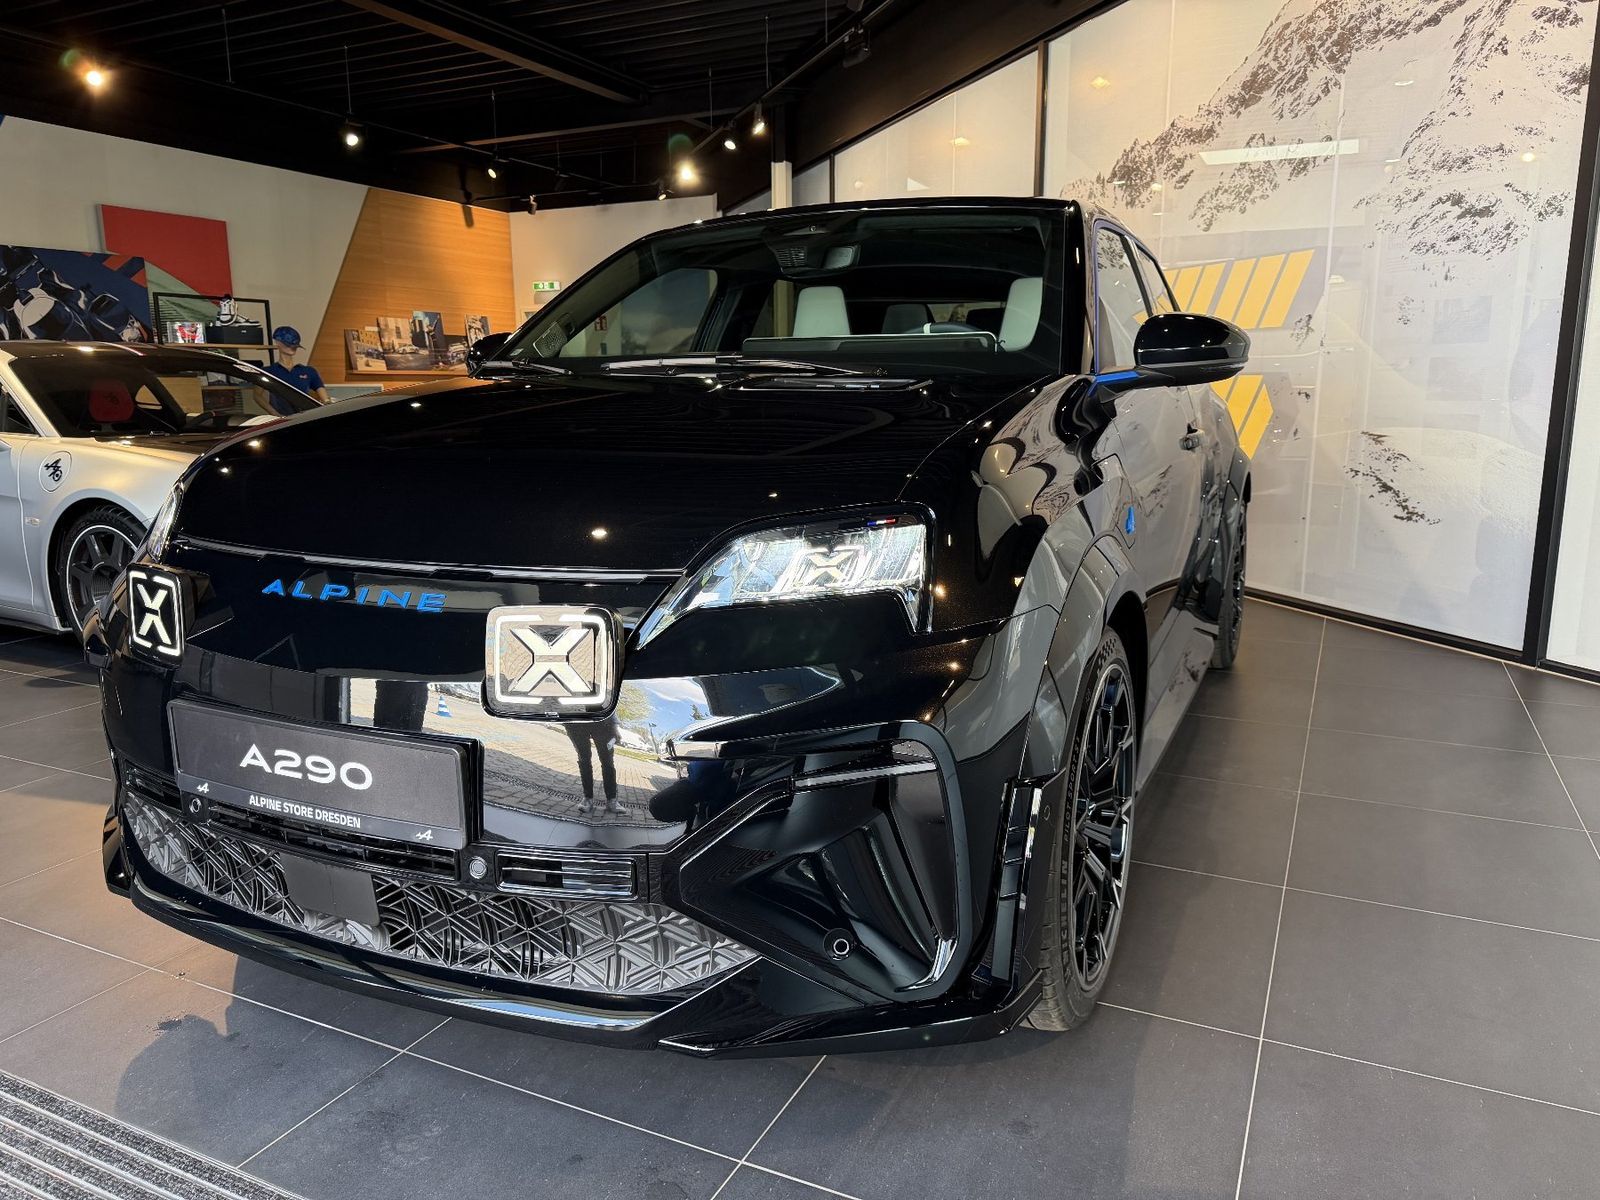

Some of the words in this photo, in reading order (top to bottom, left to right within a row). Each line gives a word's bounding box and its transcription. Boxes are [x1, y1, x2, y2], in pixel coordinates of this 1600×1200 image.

[261, 578, 447, 613] ALPINE
[239, 743, 373, 791] A290
[1067, 756, 1079, 799] SPORT
[249, 793, 282, 813] ALPINE
[283, 801, 314, 820] STORE
[315, 808, 361, 829] DRESDEN
[1062, 801, 1073, 842] PILOT
[1060, 859, 1071, 967] MICHELIN
